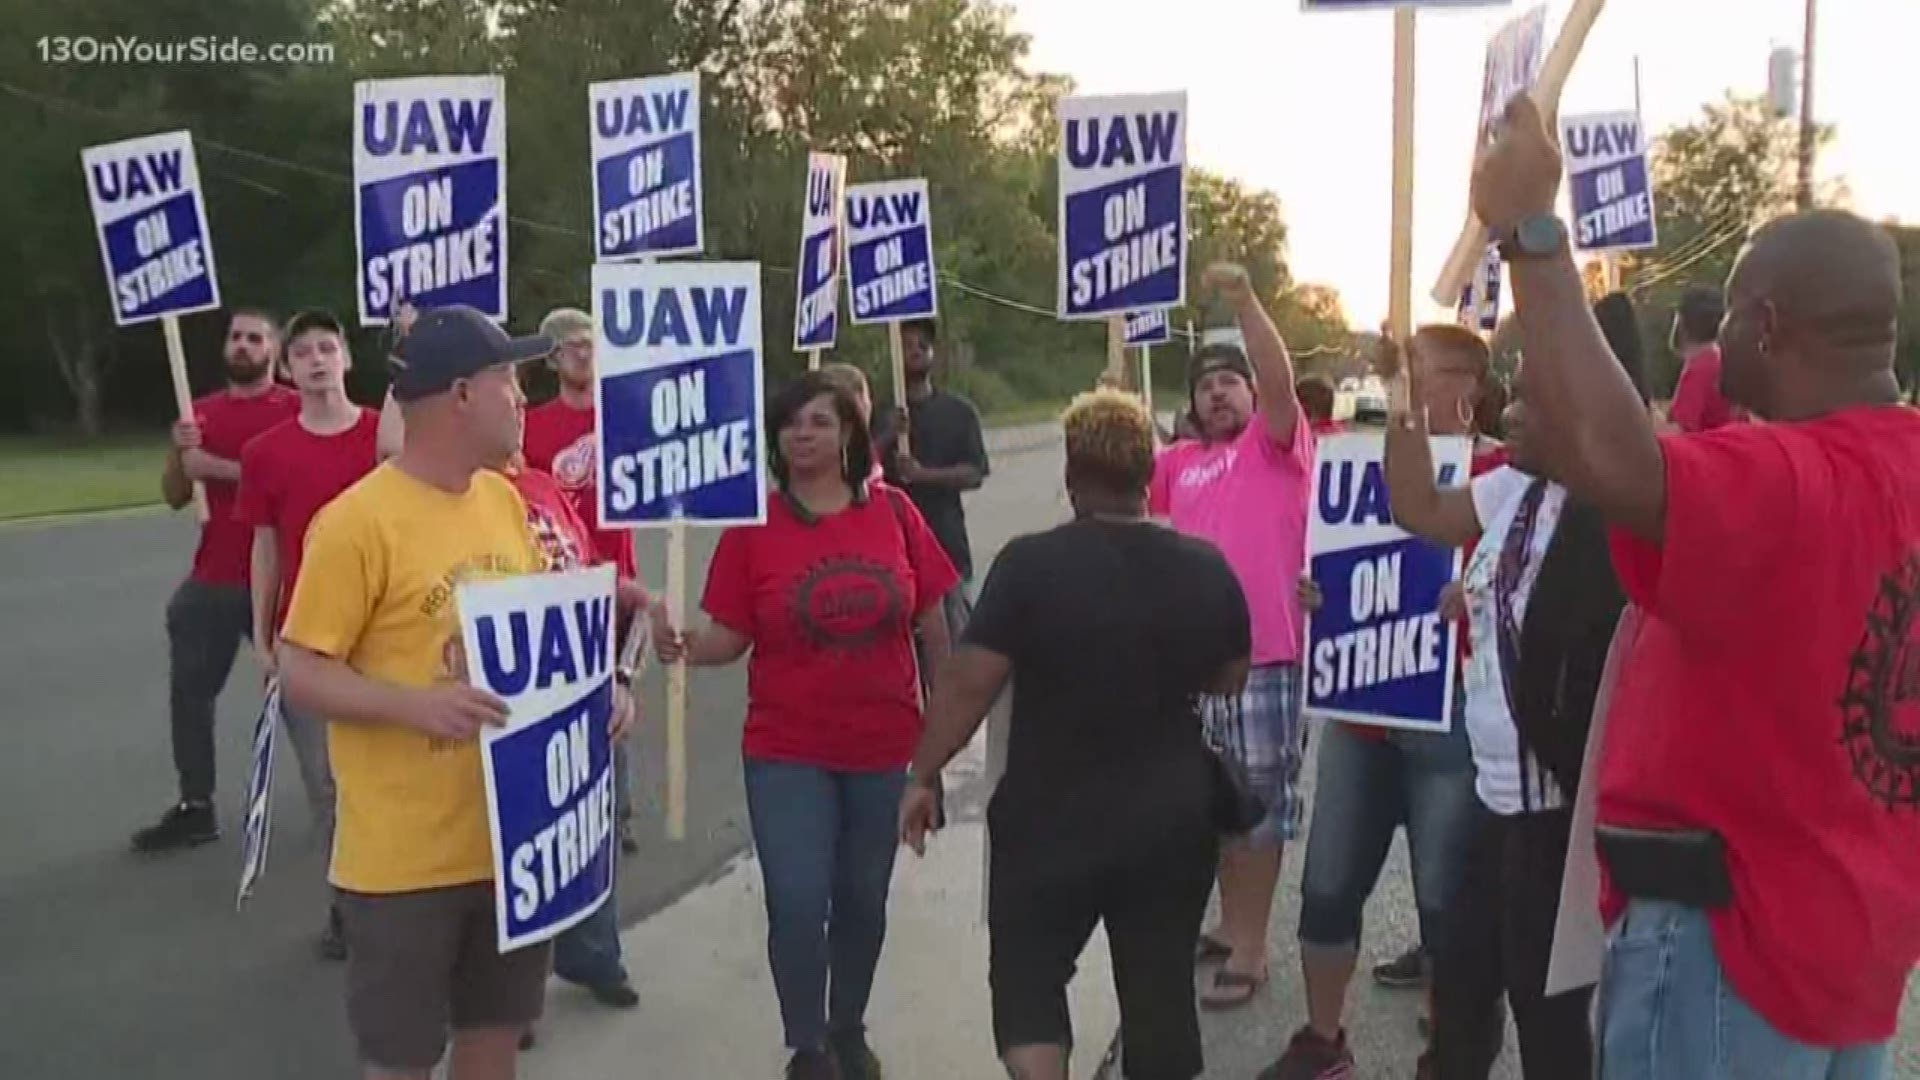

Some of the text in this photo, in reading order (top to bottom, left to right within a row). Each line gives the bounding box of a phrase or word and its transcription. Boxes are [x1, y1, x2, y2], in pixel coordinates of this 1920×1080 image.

[363, 98, 493, 157] UAW
[597, 89, 689, 138] UAW
[1066, 110, 1178, 169] UAW
[1567, 123, 1637, 158] UAW
[93, 149, 182, 202] UAW
[629, 147, 663, 197] ON
[809, 169, 832, 216] UA
[1596, 167, 1625, 204] ON
[134, 209, 172, 258] ON
[403, 176, 453, 239] ON
[603, 179, 693, 250] STRIKE
[847, 191, 921, 229] UAW
[1104, 182, 1146, 242] ON
[1580, 191, 1649, 244] STRIKE
[118, 238, 205, 312] STRIKE
[367, 221, 494, 308] STRIKE
[874, 236, 904, 274] ON
[1072, 220, 1178, 307] STRIKE
[602, 287, 747, 348] UAW
[855, 261, 930, 316] STRIKE
[651, 368, 706, 434] ON
[611, 419, 751, 512] STRIKE
[1350, 551, 1401, 622] ON
[475, 595, 611, 697] UAW
[1313, 612, 1441, 699] STRIKE
[546, 708, 591, 809] ON
[510, 772, 611, 922] STRIKE
